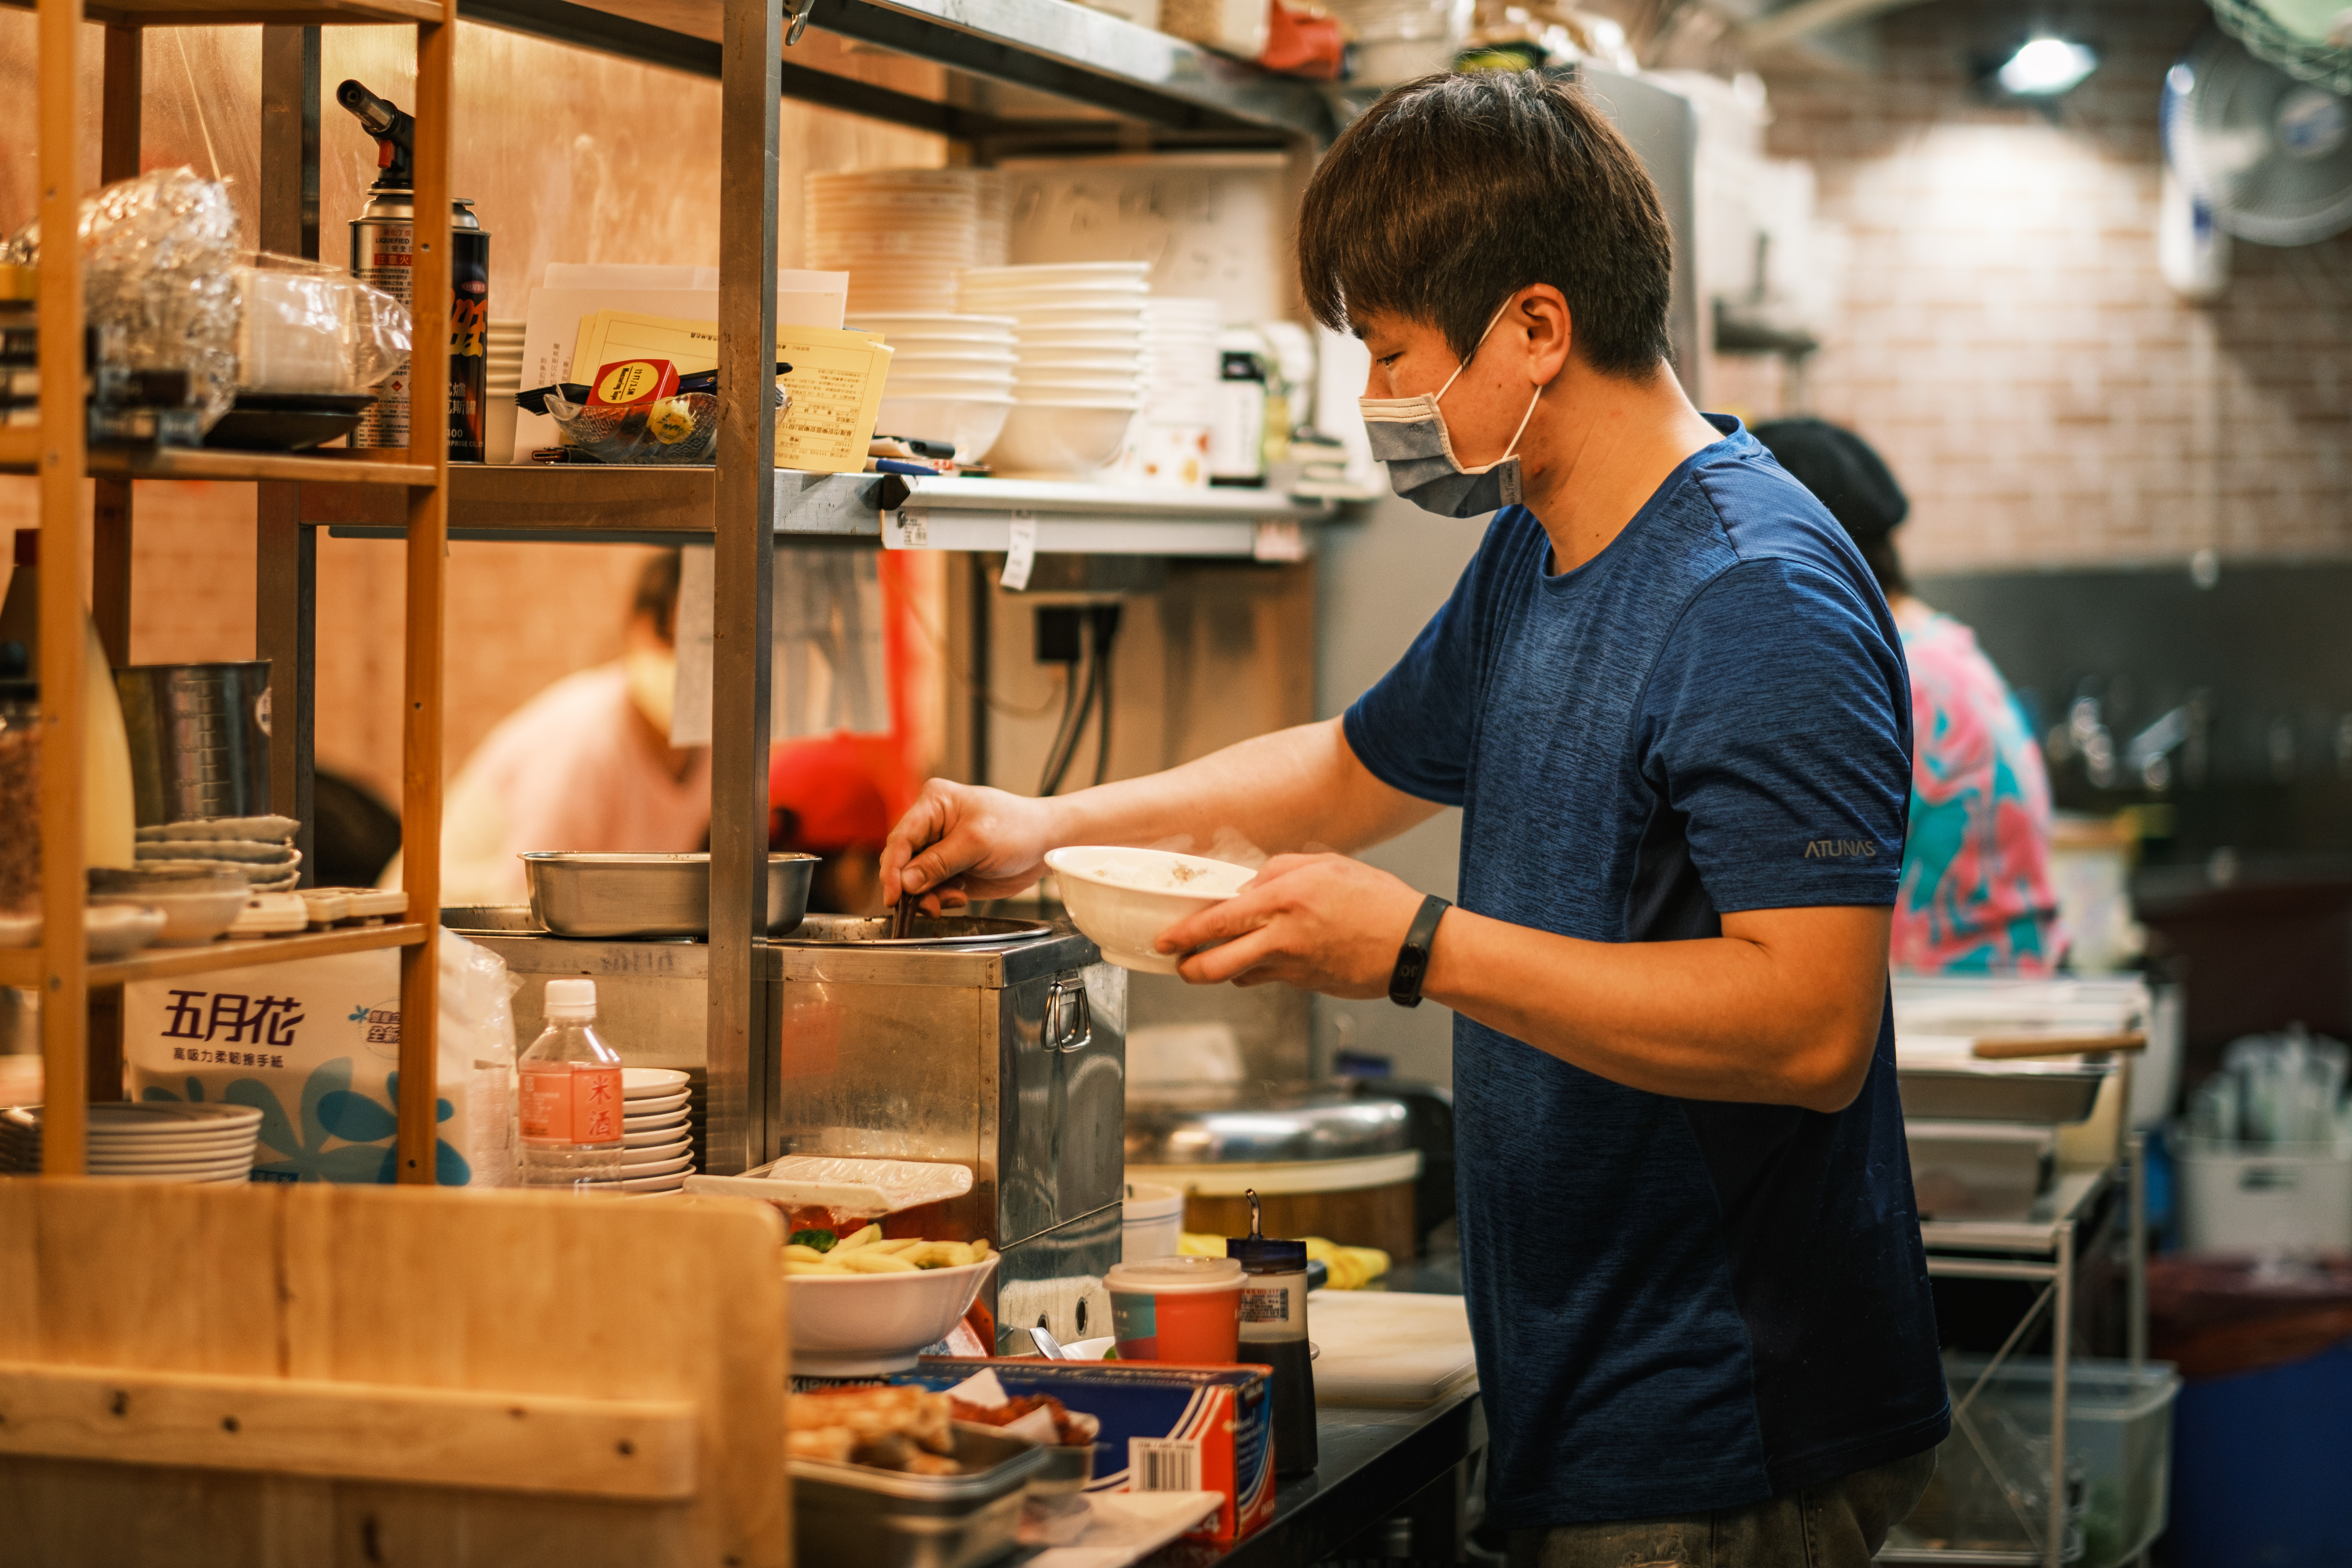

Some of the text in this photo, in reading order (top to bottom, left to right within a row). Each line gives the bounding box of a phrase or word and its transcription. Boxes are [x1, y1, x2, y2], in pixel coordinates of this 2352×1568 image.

[377, 254, 413, 265] 注意火
[610, 368, 630, 401] Measuring Tape
[1804, 840, 1876, 858] ATUNAS
[161, 989, 306, 1046] 五月花
[588, 1073, 613, 1138] 米酒
